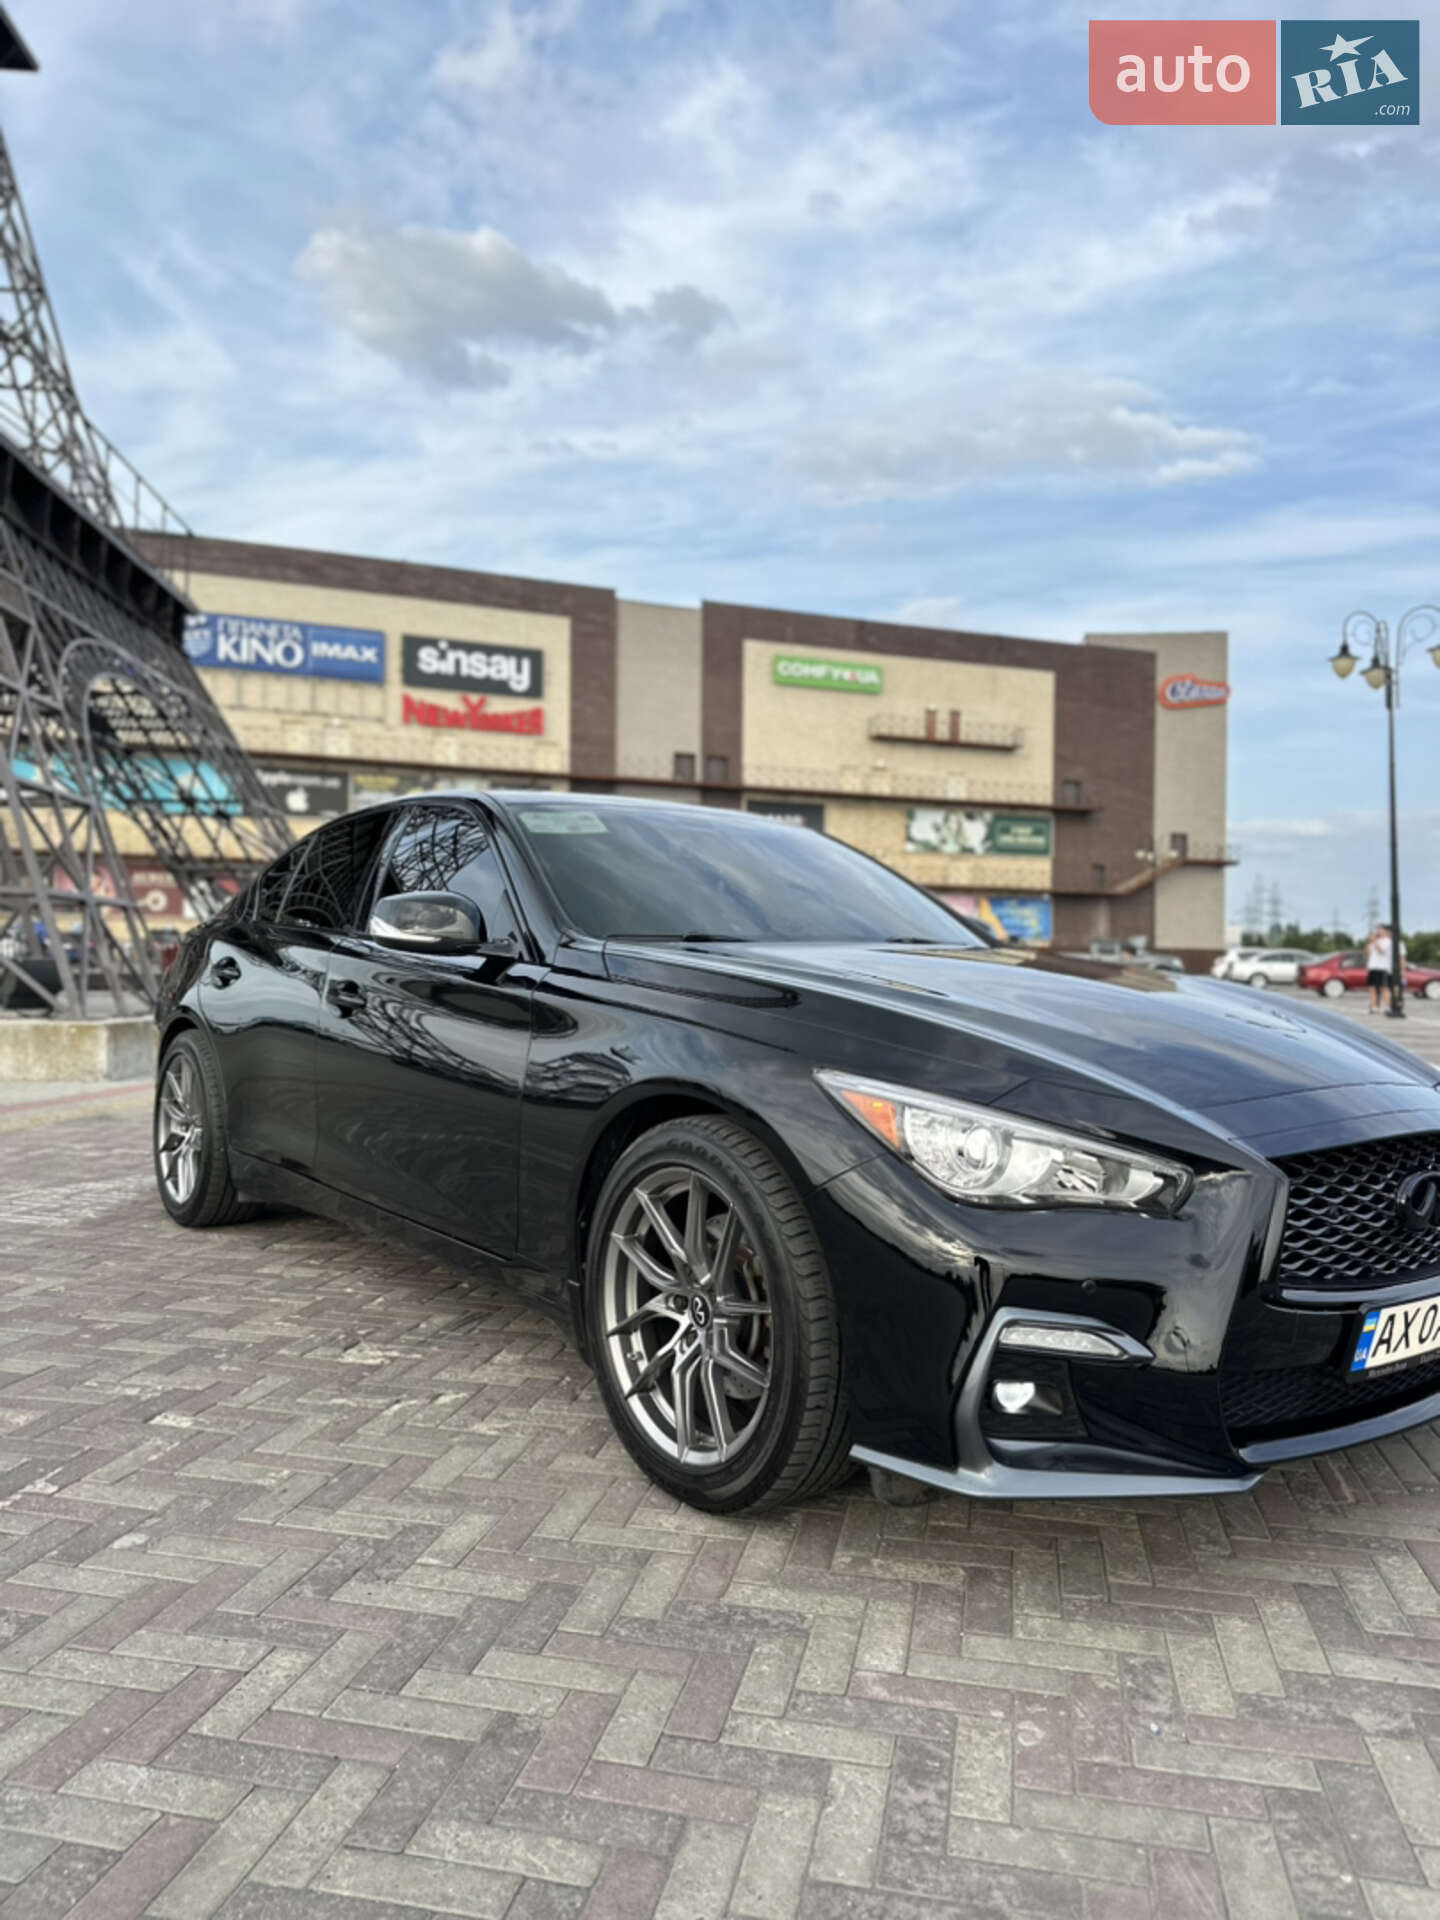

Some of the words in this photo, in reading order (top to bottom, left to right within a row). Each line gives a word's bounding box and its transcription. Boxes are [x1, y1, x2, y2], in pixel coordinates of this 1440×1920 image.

[217, 635, 305, 668] KINO
[310, 641, 378, 663] IMAX
[417, 640, 531, 692] sinsay
